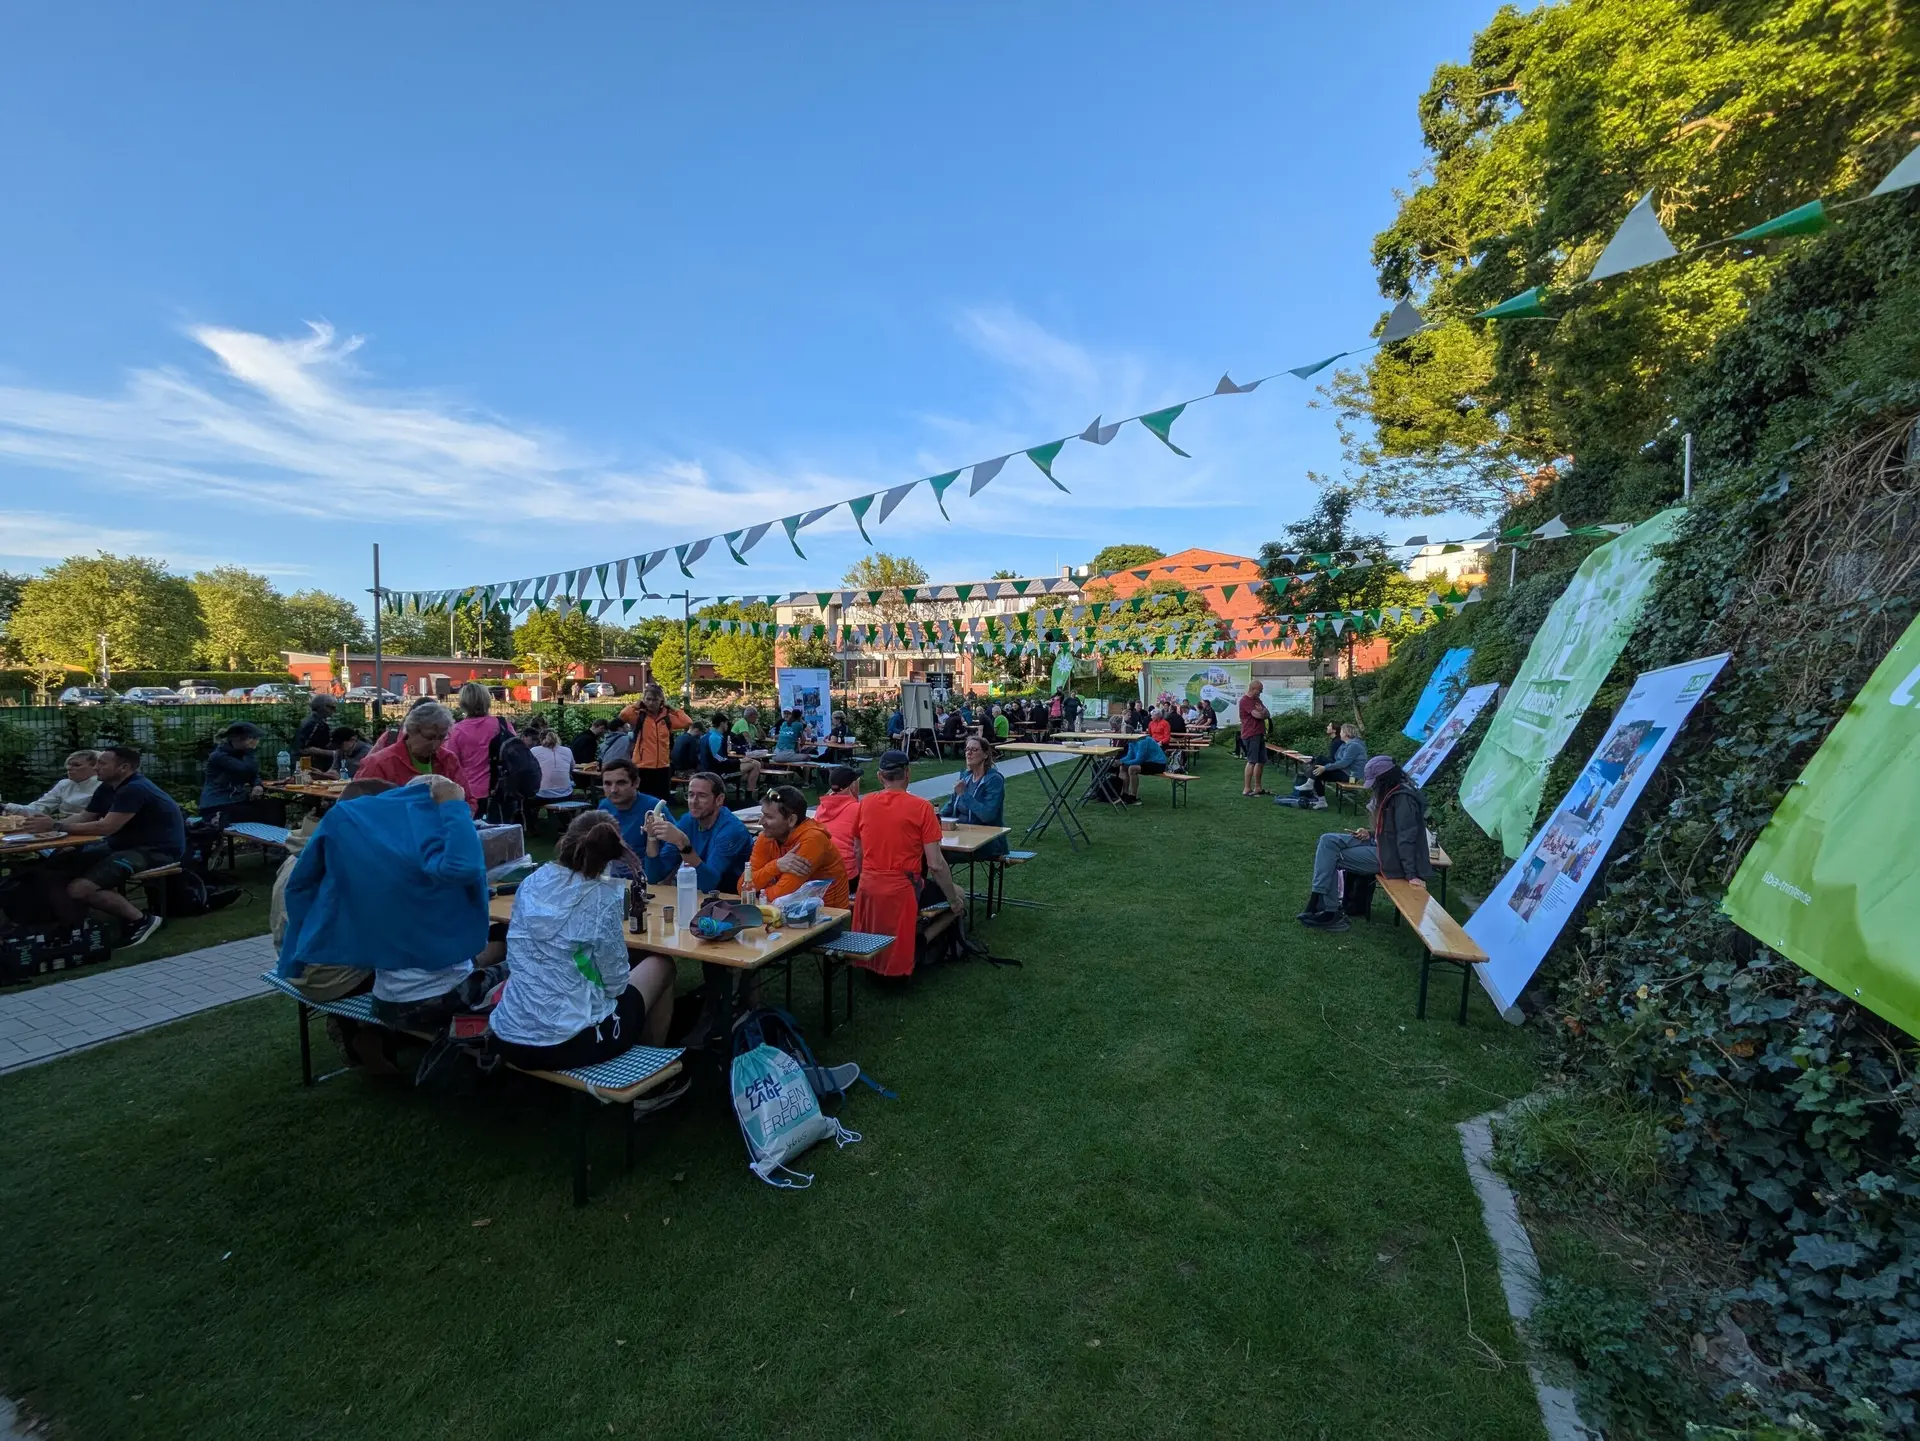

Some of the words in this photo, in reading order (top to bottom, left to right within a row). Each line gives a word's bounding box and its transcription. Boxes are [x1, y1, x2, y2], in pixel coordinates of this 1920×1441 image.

[750, 1081, 783, 1112] LAUF
[779, 1084, 806, 1110] DEIN
[763, 1097, 813, 1137] ERFOLG
